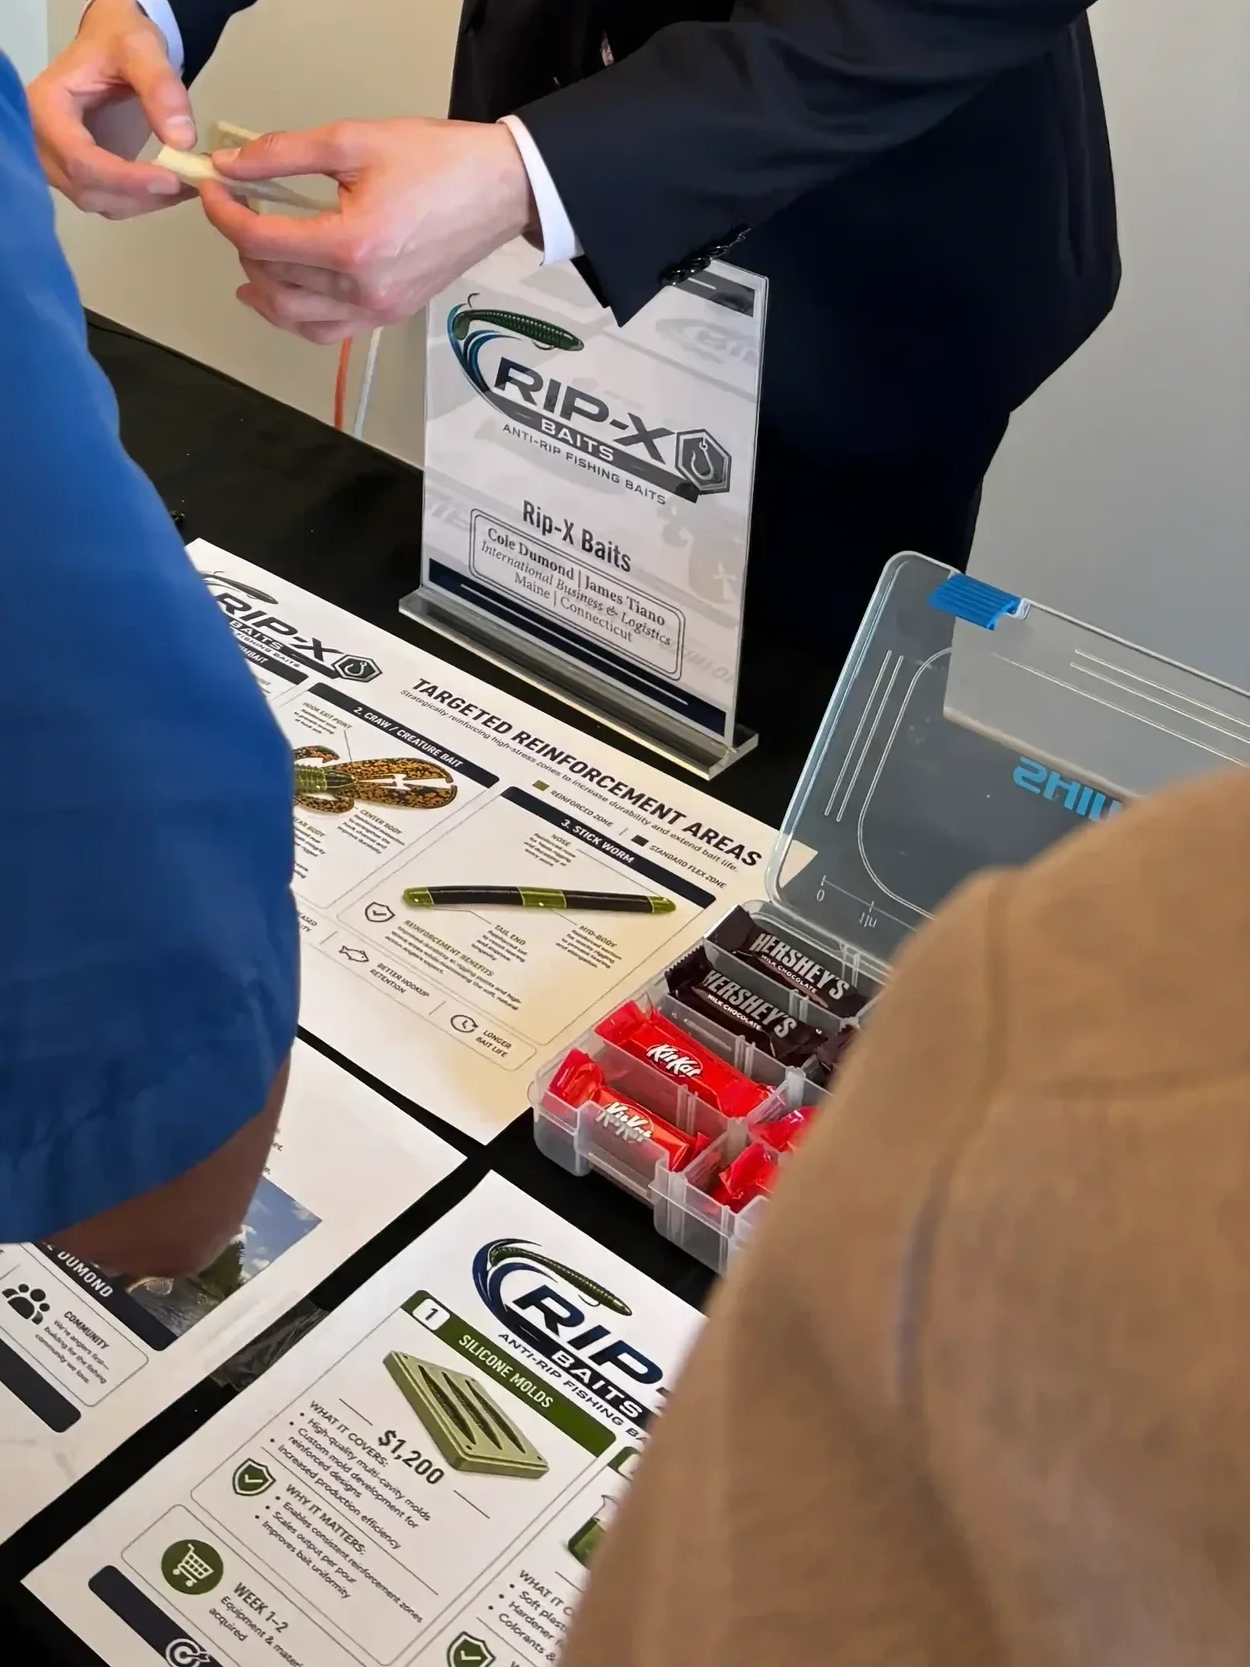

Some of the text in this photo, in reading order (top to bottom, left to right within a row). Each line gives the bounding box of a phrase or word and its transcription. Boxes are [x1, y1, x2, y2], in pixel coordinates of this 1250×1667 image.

[494, 357, 675, 465] RIP-X
[541, 419, 614, 462] BAITS
[503, 424, 666, 505] ANTI-RIP FISHING BAITS
[523, 499, 575, 545] Rip-X
[581, 528, 631, 572] Baits
[481, 541, 553, 585] International
[556, 577, 604, 612] Business
[621, 609, 671, 646] Logistics
[488, 527, 666, 626] Cole Dumond James Tiano
[514, 573, 632, 642] Maine Connecticut
[216, 593, 345, 662] RIP-X
[230, 620, 283, 650] BAITS
[354, 707, 362, 715] 2.
[364, 712, 391, 729] CRAW
[396, 728, 442, 757] CREATURE
[440, 752, 464, 768] BAIT
[400, 689, 738, 872] Strategically reinforcing high-stress zones to increase durability and extend bait life.
[411, 678, 762, 866] TARGETED REINFORCEMENT AREAS
[550, 789, 613, 827] REINFORCED ZONE
[561, 819, 636, 863] 3. STICK WORM
[649, 845, 727, 889] STANDARD FLEX ZONE
[749, 932, 850, 1000] HERSHEY'S
[761, 955, 818, 994] MILK CHOCOLATE
[701, 969, 797, 1038] HERSHEY'S
[707, 994, 762, 1031] MILK CHOCOLATE
[483, 1030, 512, 1049] LONGER
[57, 1251, 113, 1298] DUMOND
[64, 1311, 110, 1349] COMMUNITY
[424, 1307, 439, 1321] 1
[458, 1334, 554, 1409] SILICONE MOLDS
[498, 1333, 624, 1427] ANTI-RIP FISHING
[551, 1350, 645, 1419] BAITS
[288, 1435, 362, 1499] reinforced designs
[309, 1400, 389, 1468] WHAT IT COVERS:
[378, 1429, 445, 1485] $1,200
[277, 1444, 402, 1550] Increased production efficiency
[297, 1427, 420, 1529] Custom mold development for
[307, 1418, 431, 1522] High-quality multi-cavity molds
[272, 1511, 357, 1584] Scales output per pour
[285, 1483, 367, 1555] WHY IT MATTERS:
[262, 1520, 351, 1599] Improves bait uniformity
[282, 1501, 423, 1623] Enables consistent reinforcement zones
[519, 1569, 564, 1607] WHAT IT
[208, 1607, 248, 1642] acquired
[220, 1595, 266, 1638] Equipment
[264, 1635, 274, 1646] &
[233, 1582, 269, 1615] WEEK
[508, 1601, 555, 1640] Hardener
[519, 1590, 541, 1611] Soft
[498, 1613, 545, 1654] Colorants
